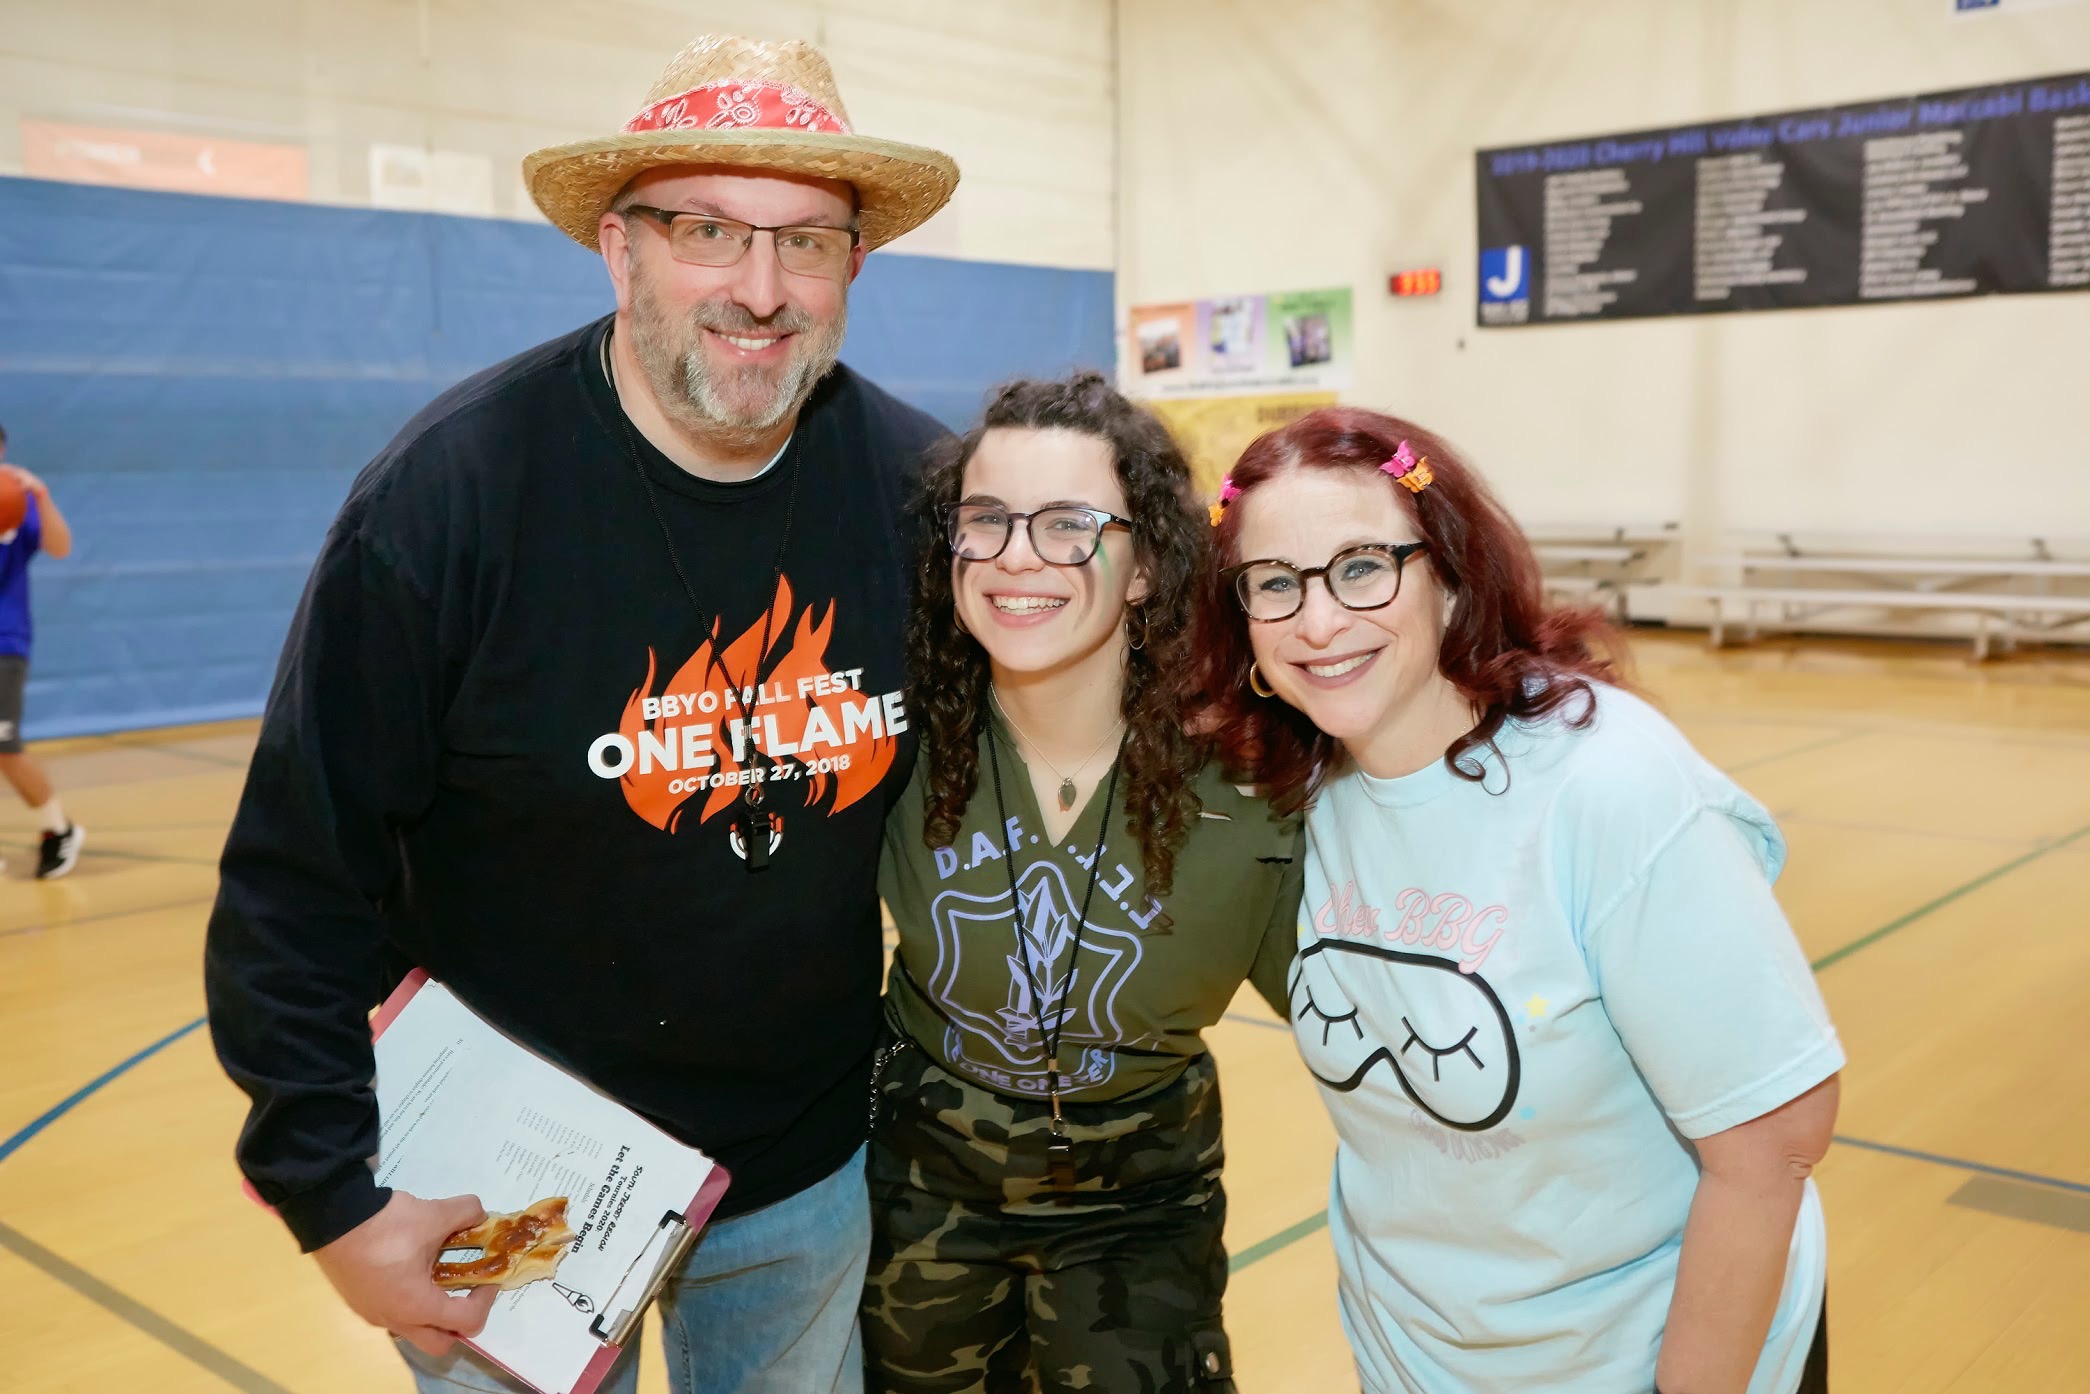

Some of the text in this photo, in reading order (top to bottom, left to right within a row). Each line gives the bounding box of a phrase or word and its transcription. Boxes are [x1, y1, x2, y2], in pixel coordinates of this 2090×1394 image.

[1595, 138, 1664, 163] Cherry
[1668, 130, 1706, 155] Hill
[1837, 106, 1913, 137] Junior
[1919, 87, 2023, 124] Maccabi
[1486, 244, 1523, 298] J
[641, 667, 864, 721] BBYO FALL FEST
[587, 691, 909, 780] ONE FLAME
[668, 754, 851, 795] OCTOBER 27, 2018
[1384, 888, 1509, 975] BBG
[605, 1164, 620, 1183] the
[615, 1144, 630, 1163] Let
[587, 1184, 611, 1221] Games
[594, 1176, 628, 1233] Tournies 2020:
[597, 1165, 643, 1252] SOUTH JERSEY REGION
[570, 1220, 593, 1254] Begin
